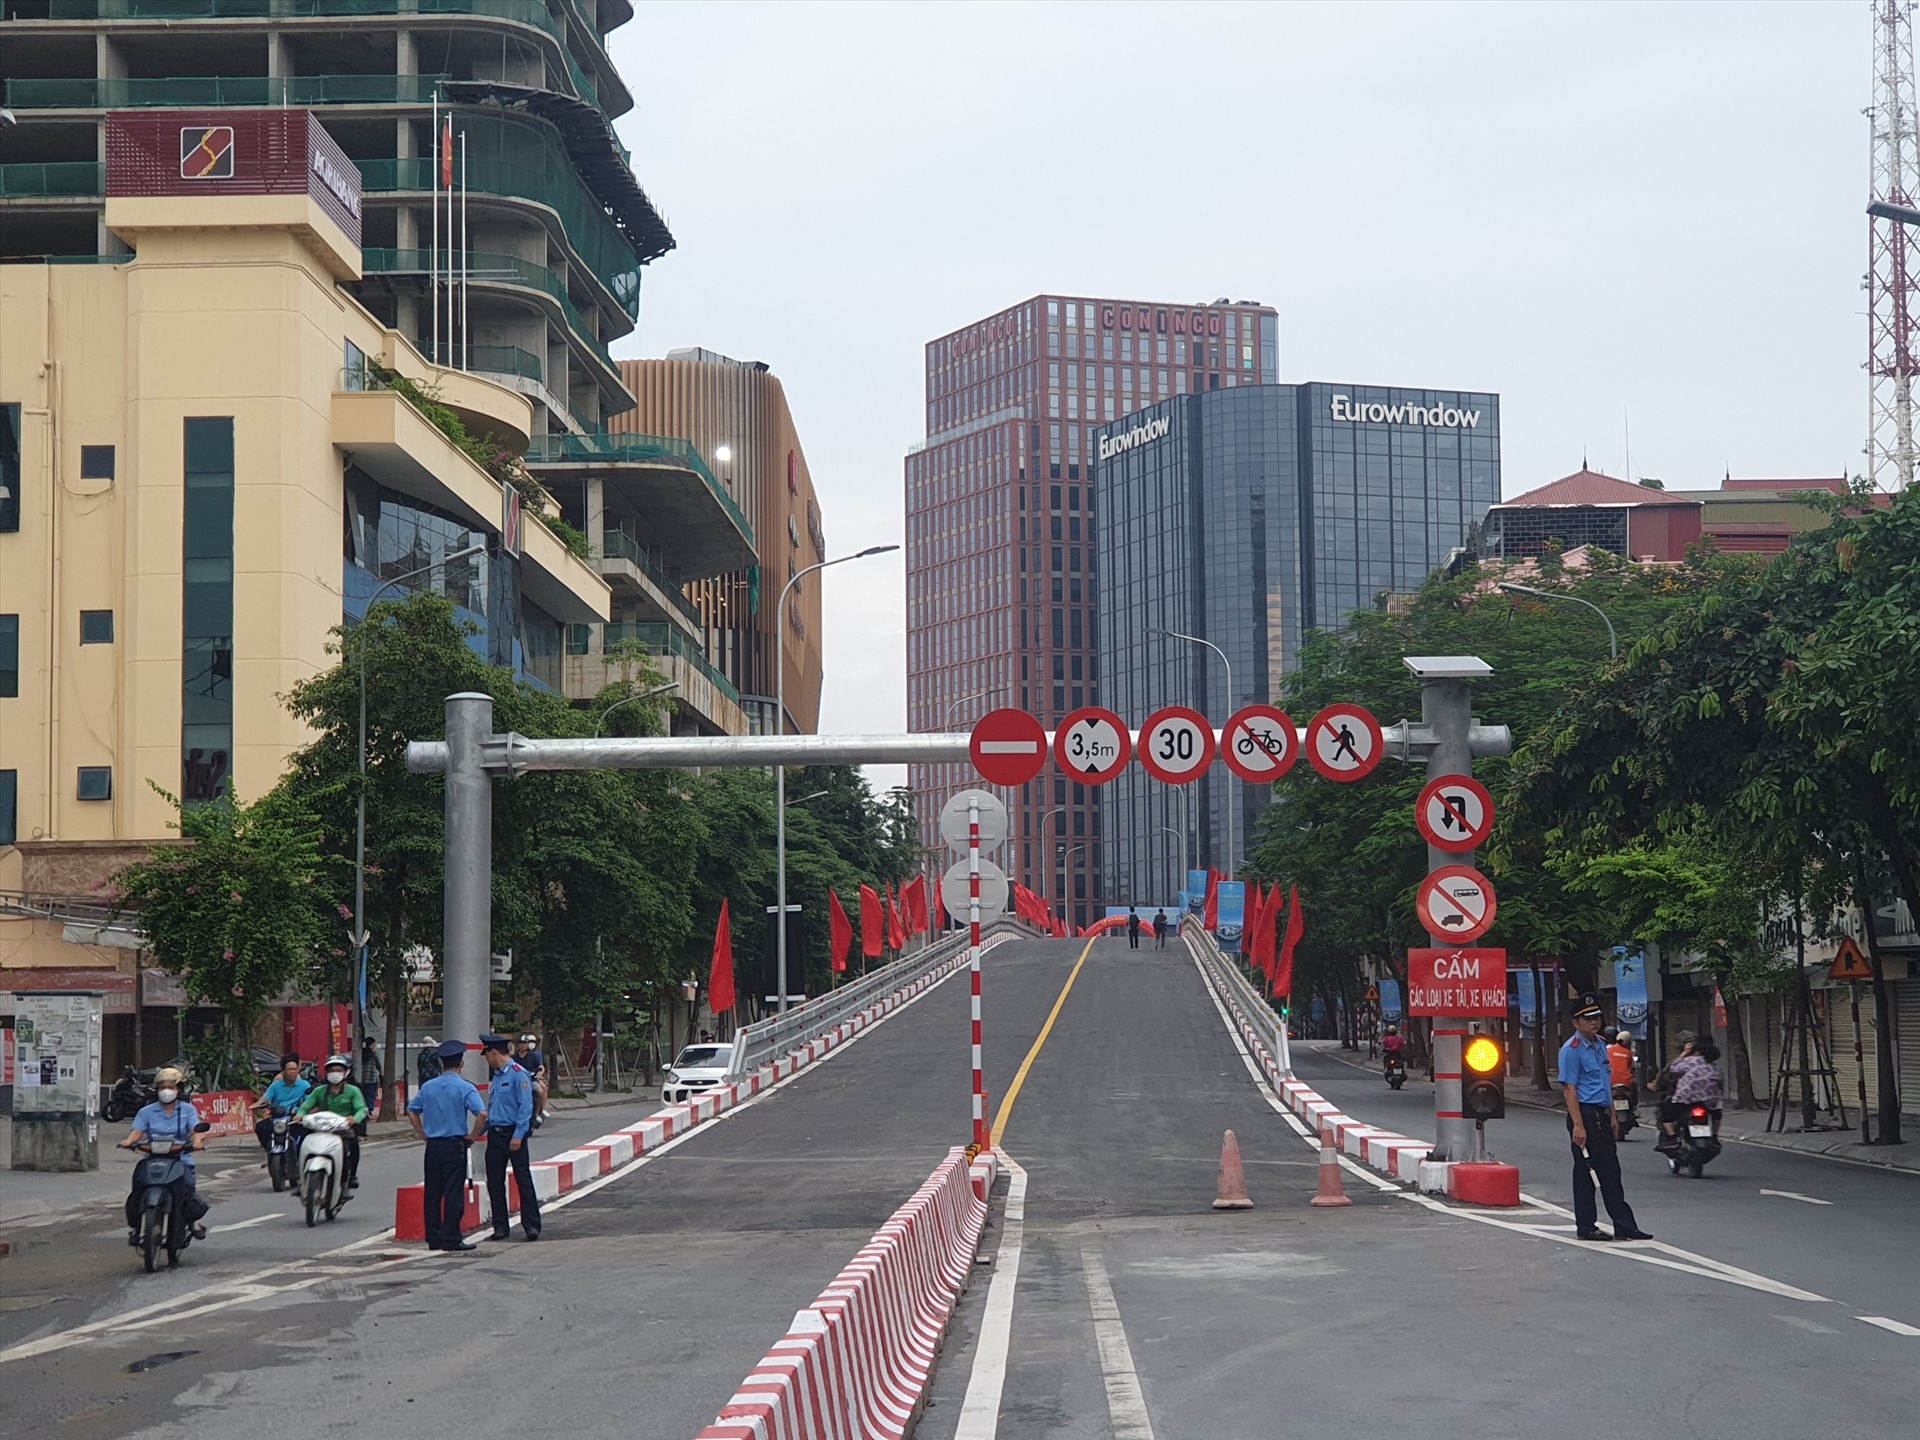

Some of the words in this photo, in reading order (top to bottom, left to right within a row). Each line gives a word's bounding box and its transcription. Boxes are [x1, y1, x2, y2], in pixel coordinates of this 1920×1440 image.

[1103, 309, 1220, 335] CONINCO
[952, 318, 1012, 358] CONINCO
[1331, 394, 1481, 429] Eurowindow
[1099, 415, 1170, 460] Eurowindow
[1072, 733, 1114, 760] 3,5m
[1159, 728, 1193, 760] 30
[1433, 950, 1480, 979] CẤM
[1409, 985, 1424, 1007] CÁC
[1426, 989, 1442, 1010] LOẠI
[1443, 989, 1453, 1007] XE
[1455, 983, 1469, 1009] TẢI,
[1470, 989, 1480, 1007] XE
[1482, 985, 1506, 1007] KHÁCH
